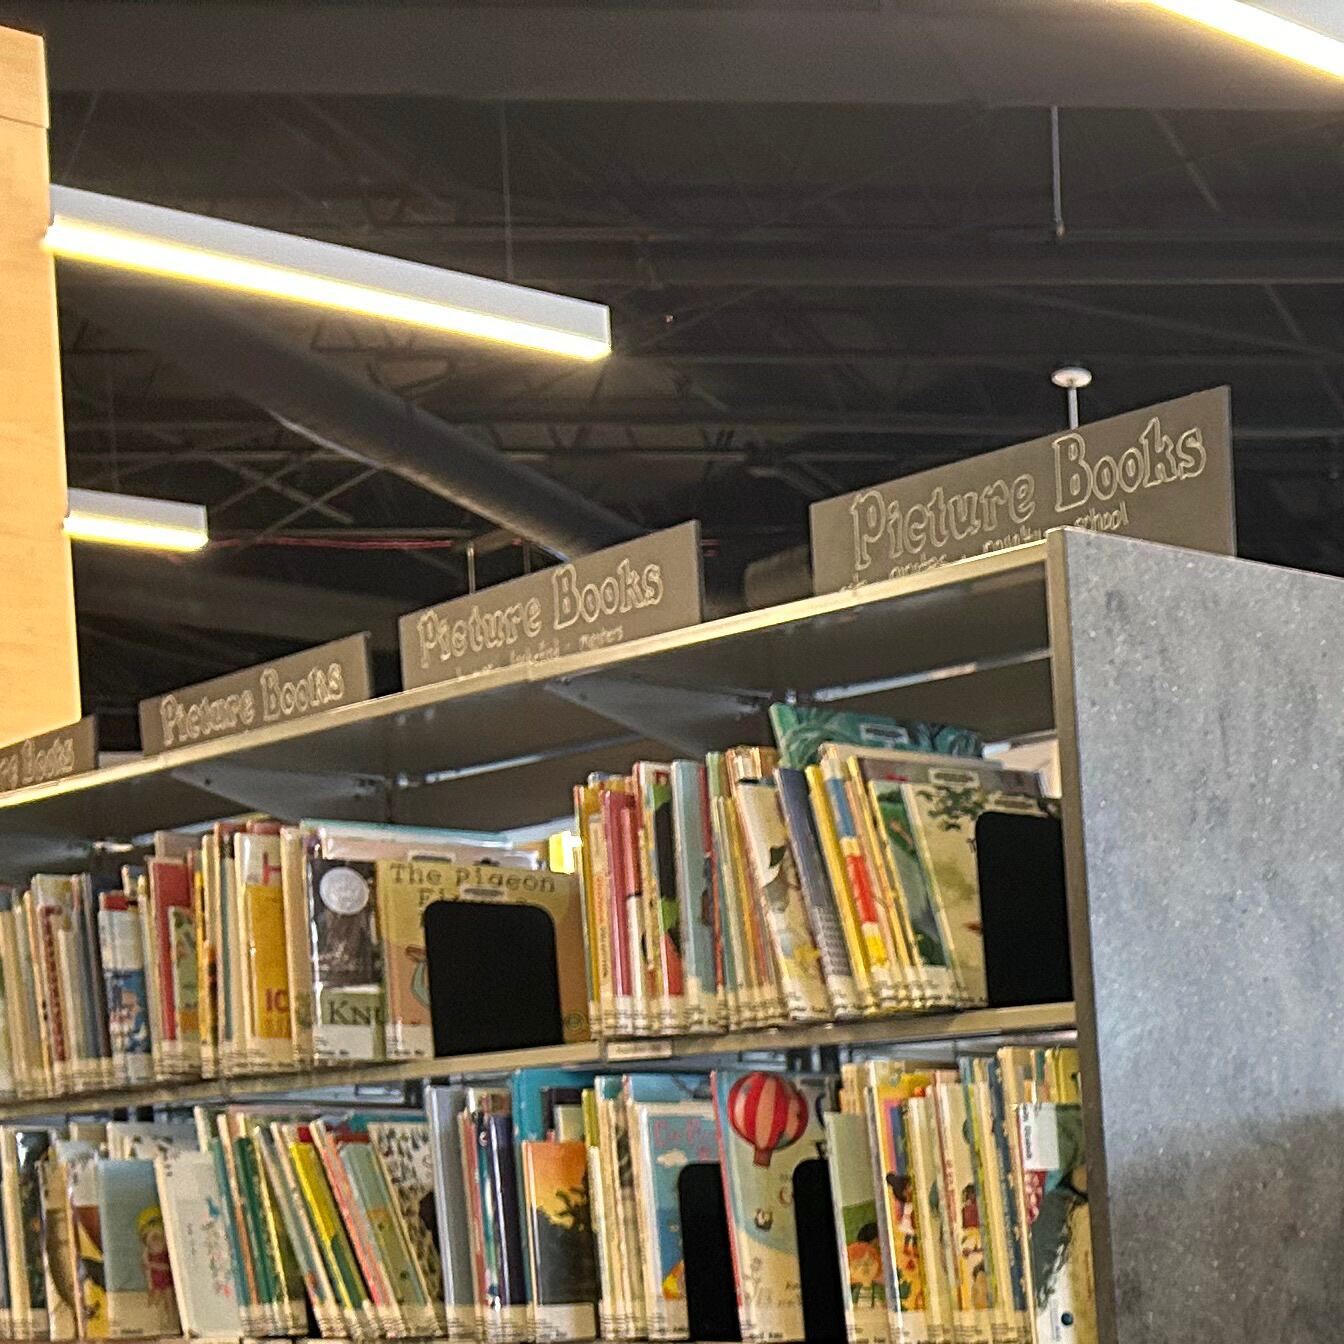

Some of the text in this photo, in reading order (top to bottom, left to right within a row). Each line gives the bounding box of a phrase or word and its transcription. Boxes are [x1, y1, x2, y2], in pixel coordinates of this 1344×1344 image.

[849, 473, 1036, 571] Picture
[1051, 416, 1207, 512] Books
[417, 597, 543, 669] Picture
[552, 557, 664, 630] Books
[160, 662, 346, 747] Picture Books
[390, 862, 556, 895] The Pigeon
